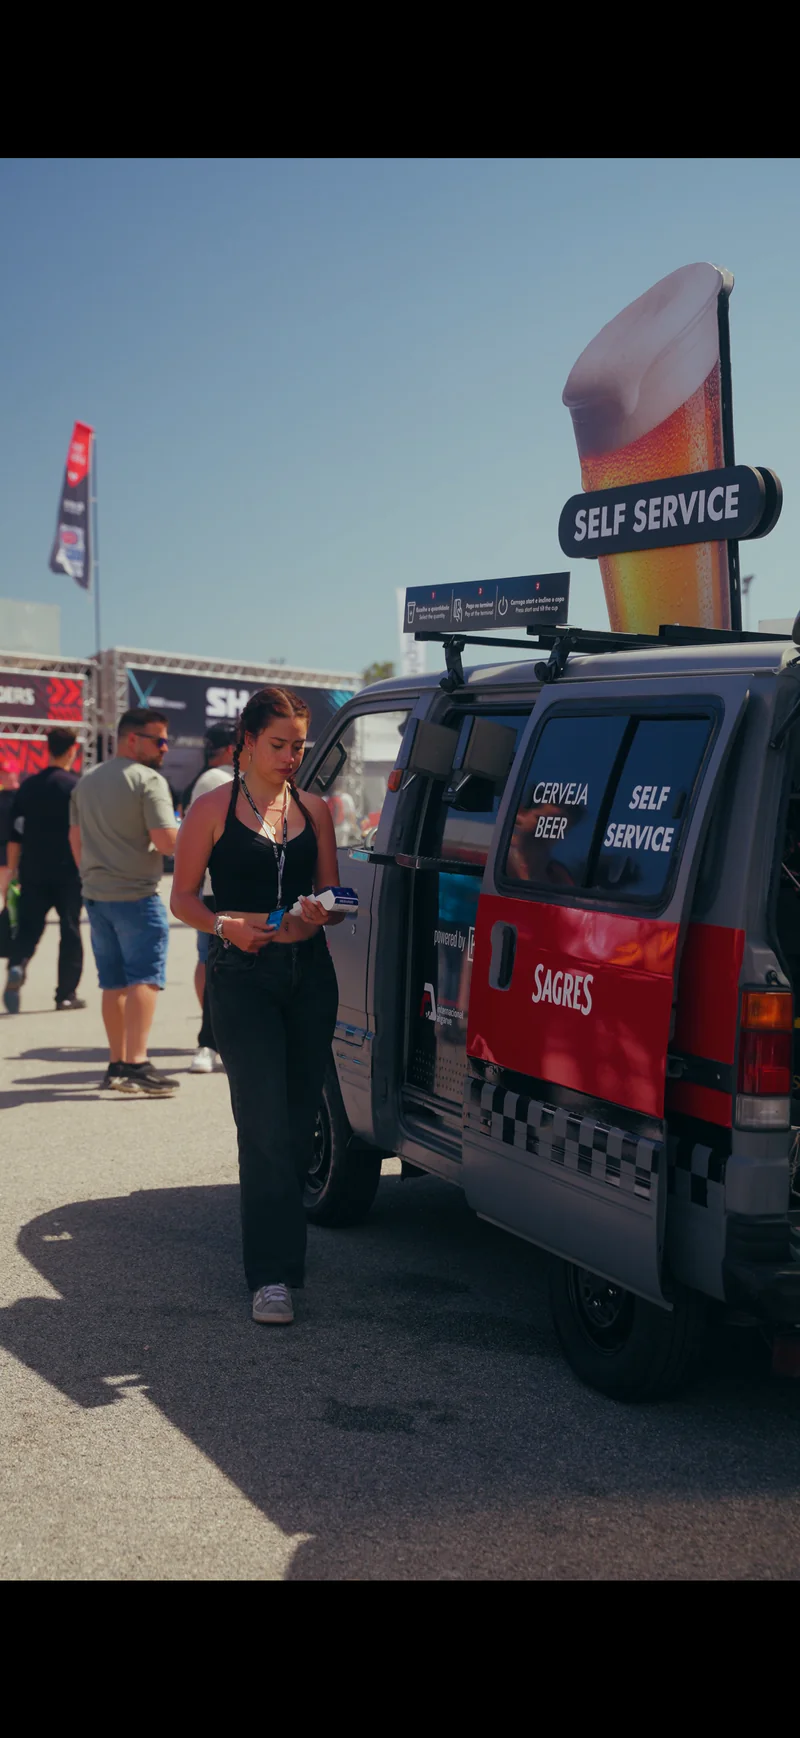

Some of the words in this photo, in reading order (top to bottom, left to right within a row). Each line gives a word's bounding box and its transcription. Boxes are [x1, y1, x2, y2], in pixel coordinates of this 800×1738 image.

[573, 503, 626, 541] SELF
[632, 484, 739, 533] SERVICE
[533, 781, 588, 806] CERVEJA
[628, 785, 671, 810] SELF
[534, 816, 568, 839] BEER
[604, 822, 675, 852] SERVICE
[434, 929, 458, 948] powered
[458, 932, 466, 952] by
[531, 963, 594, 1016] SAGRES
